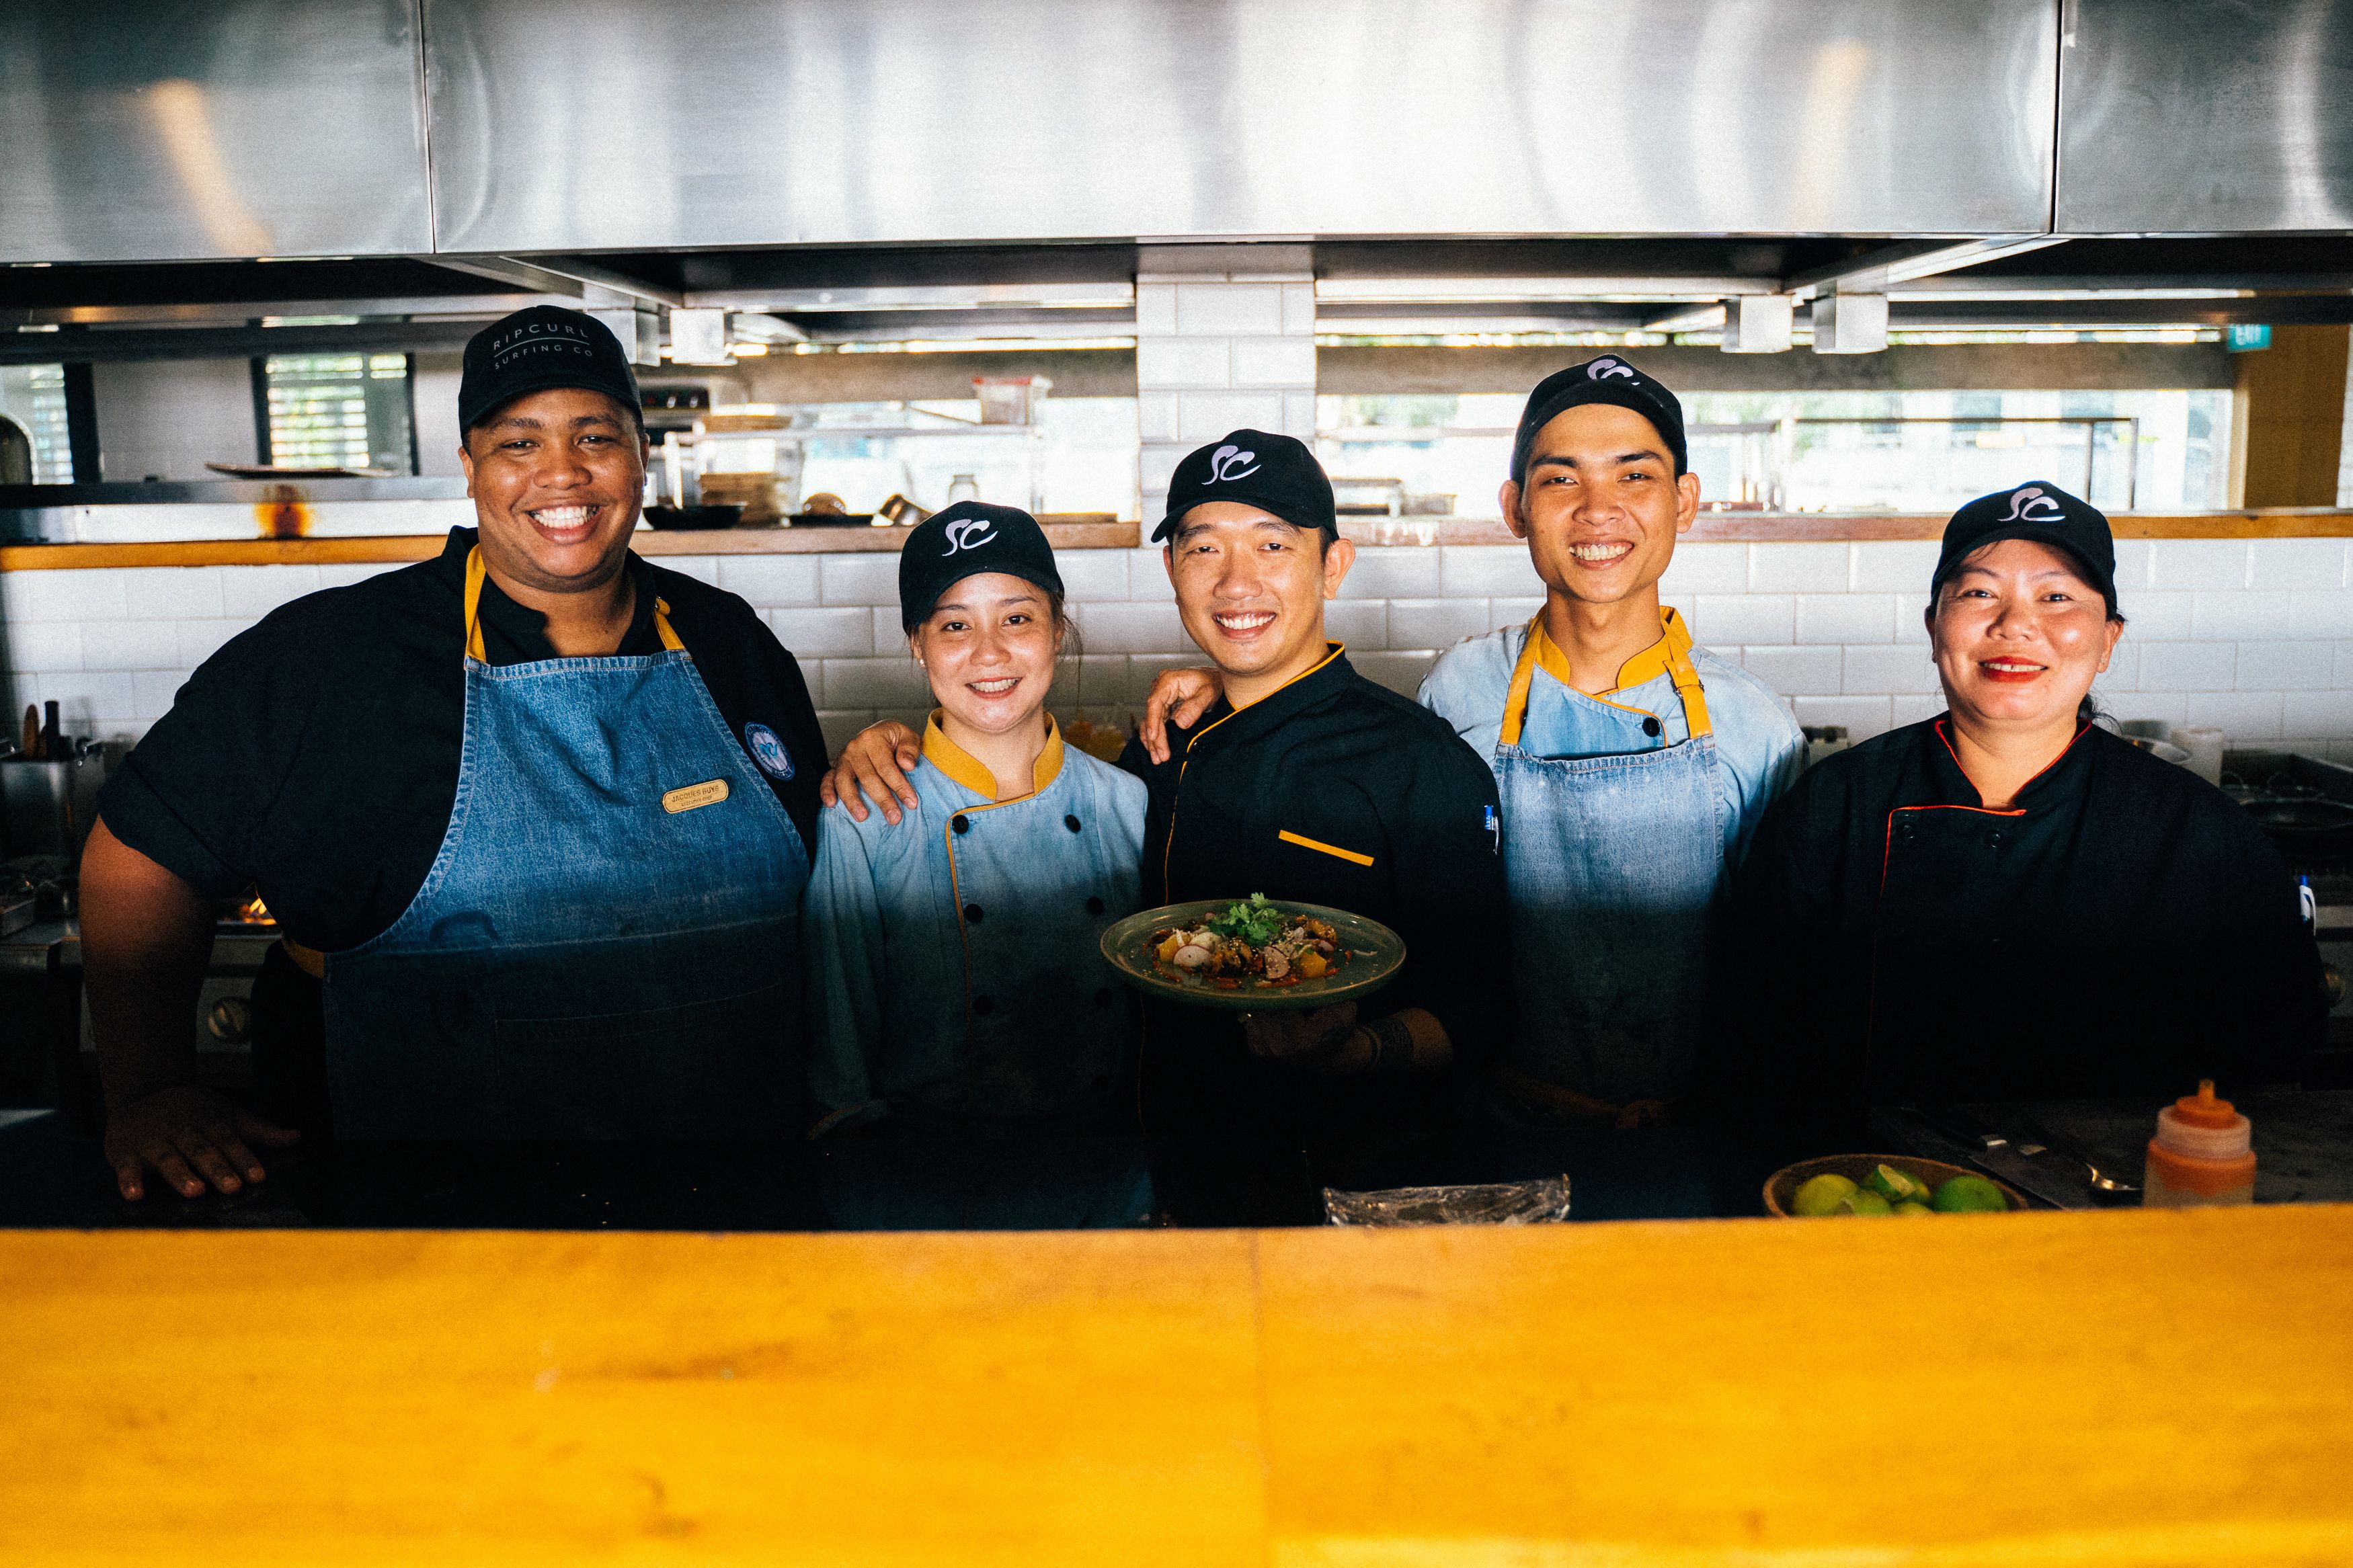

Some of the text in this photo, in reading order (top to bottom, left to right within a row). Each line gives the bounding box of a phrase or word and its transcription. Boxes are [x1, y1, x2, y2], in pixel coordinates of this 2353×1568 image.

[493, 323, 589, 350] RIPCURL
[495, 344, 592, 370] SURFING CO
[672, 785, 720, 802] JACQUES BUYS
